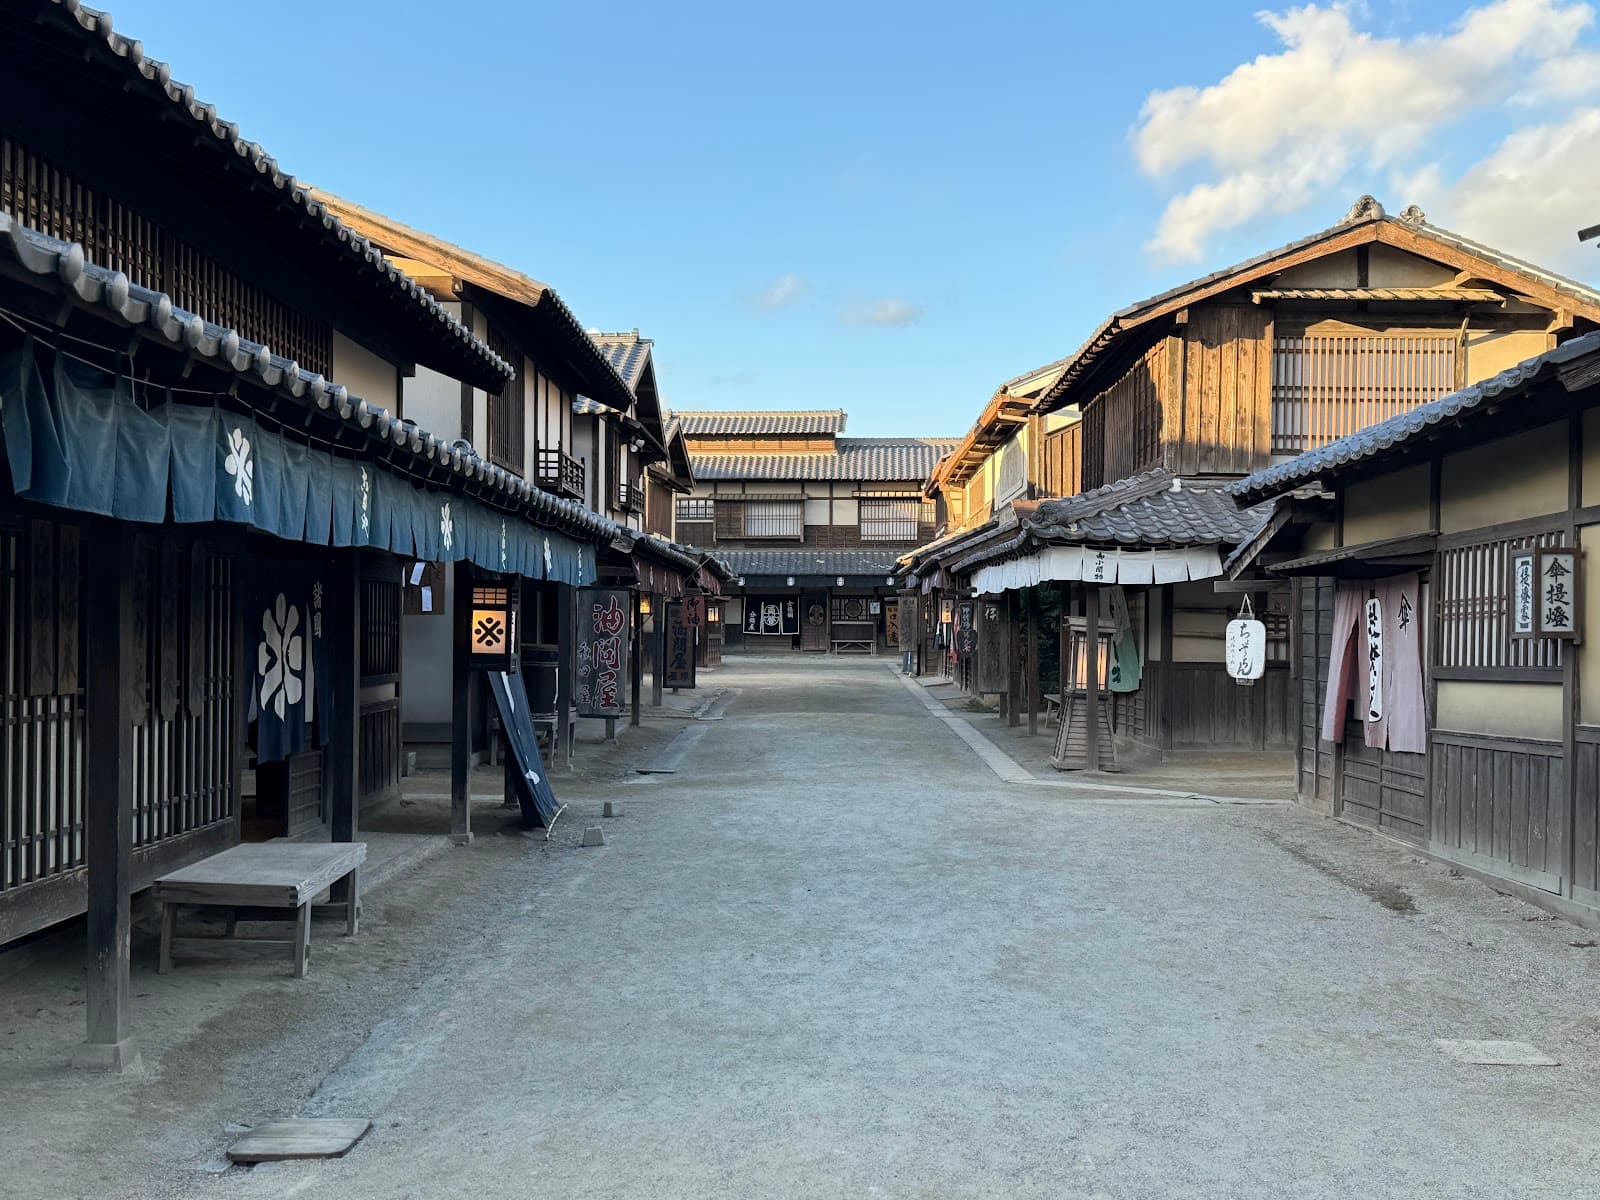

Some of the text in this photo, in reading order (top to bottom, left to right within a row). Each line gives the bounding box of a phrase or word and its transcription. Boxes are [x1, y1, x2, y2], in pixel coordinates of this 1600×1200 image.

[1398, 592, 1412, 635] 傘
[1544, 557, 1572, 627] 傘提燈
[592, 595, 625, 709] 油問屋
